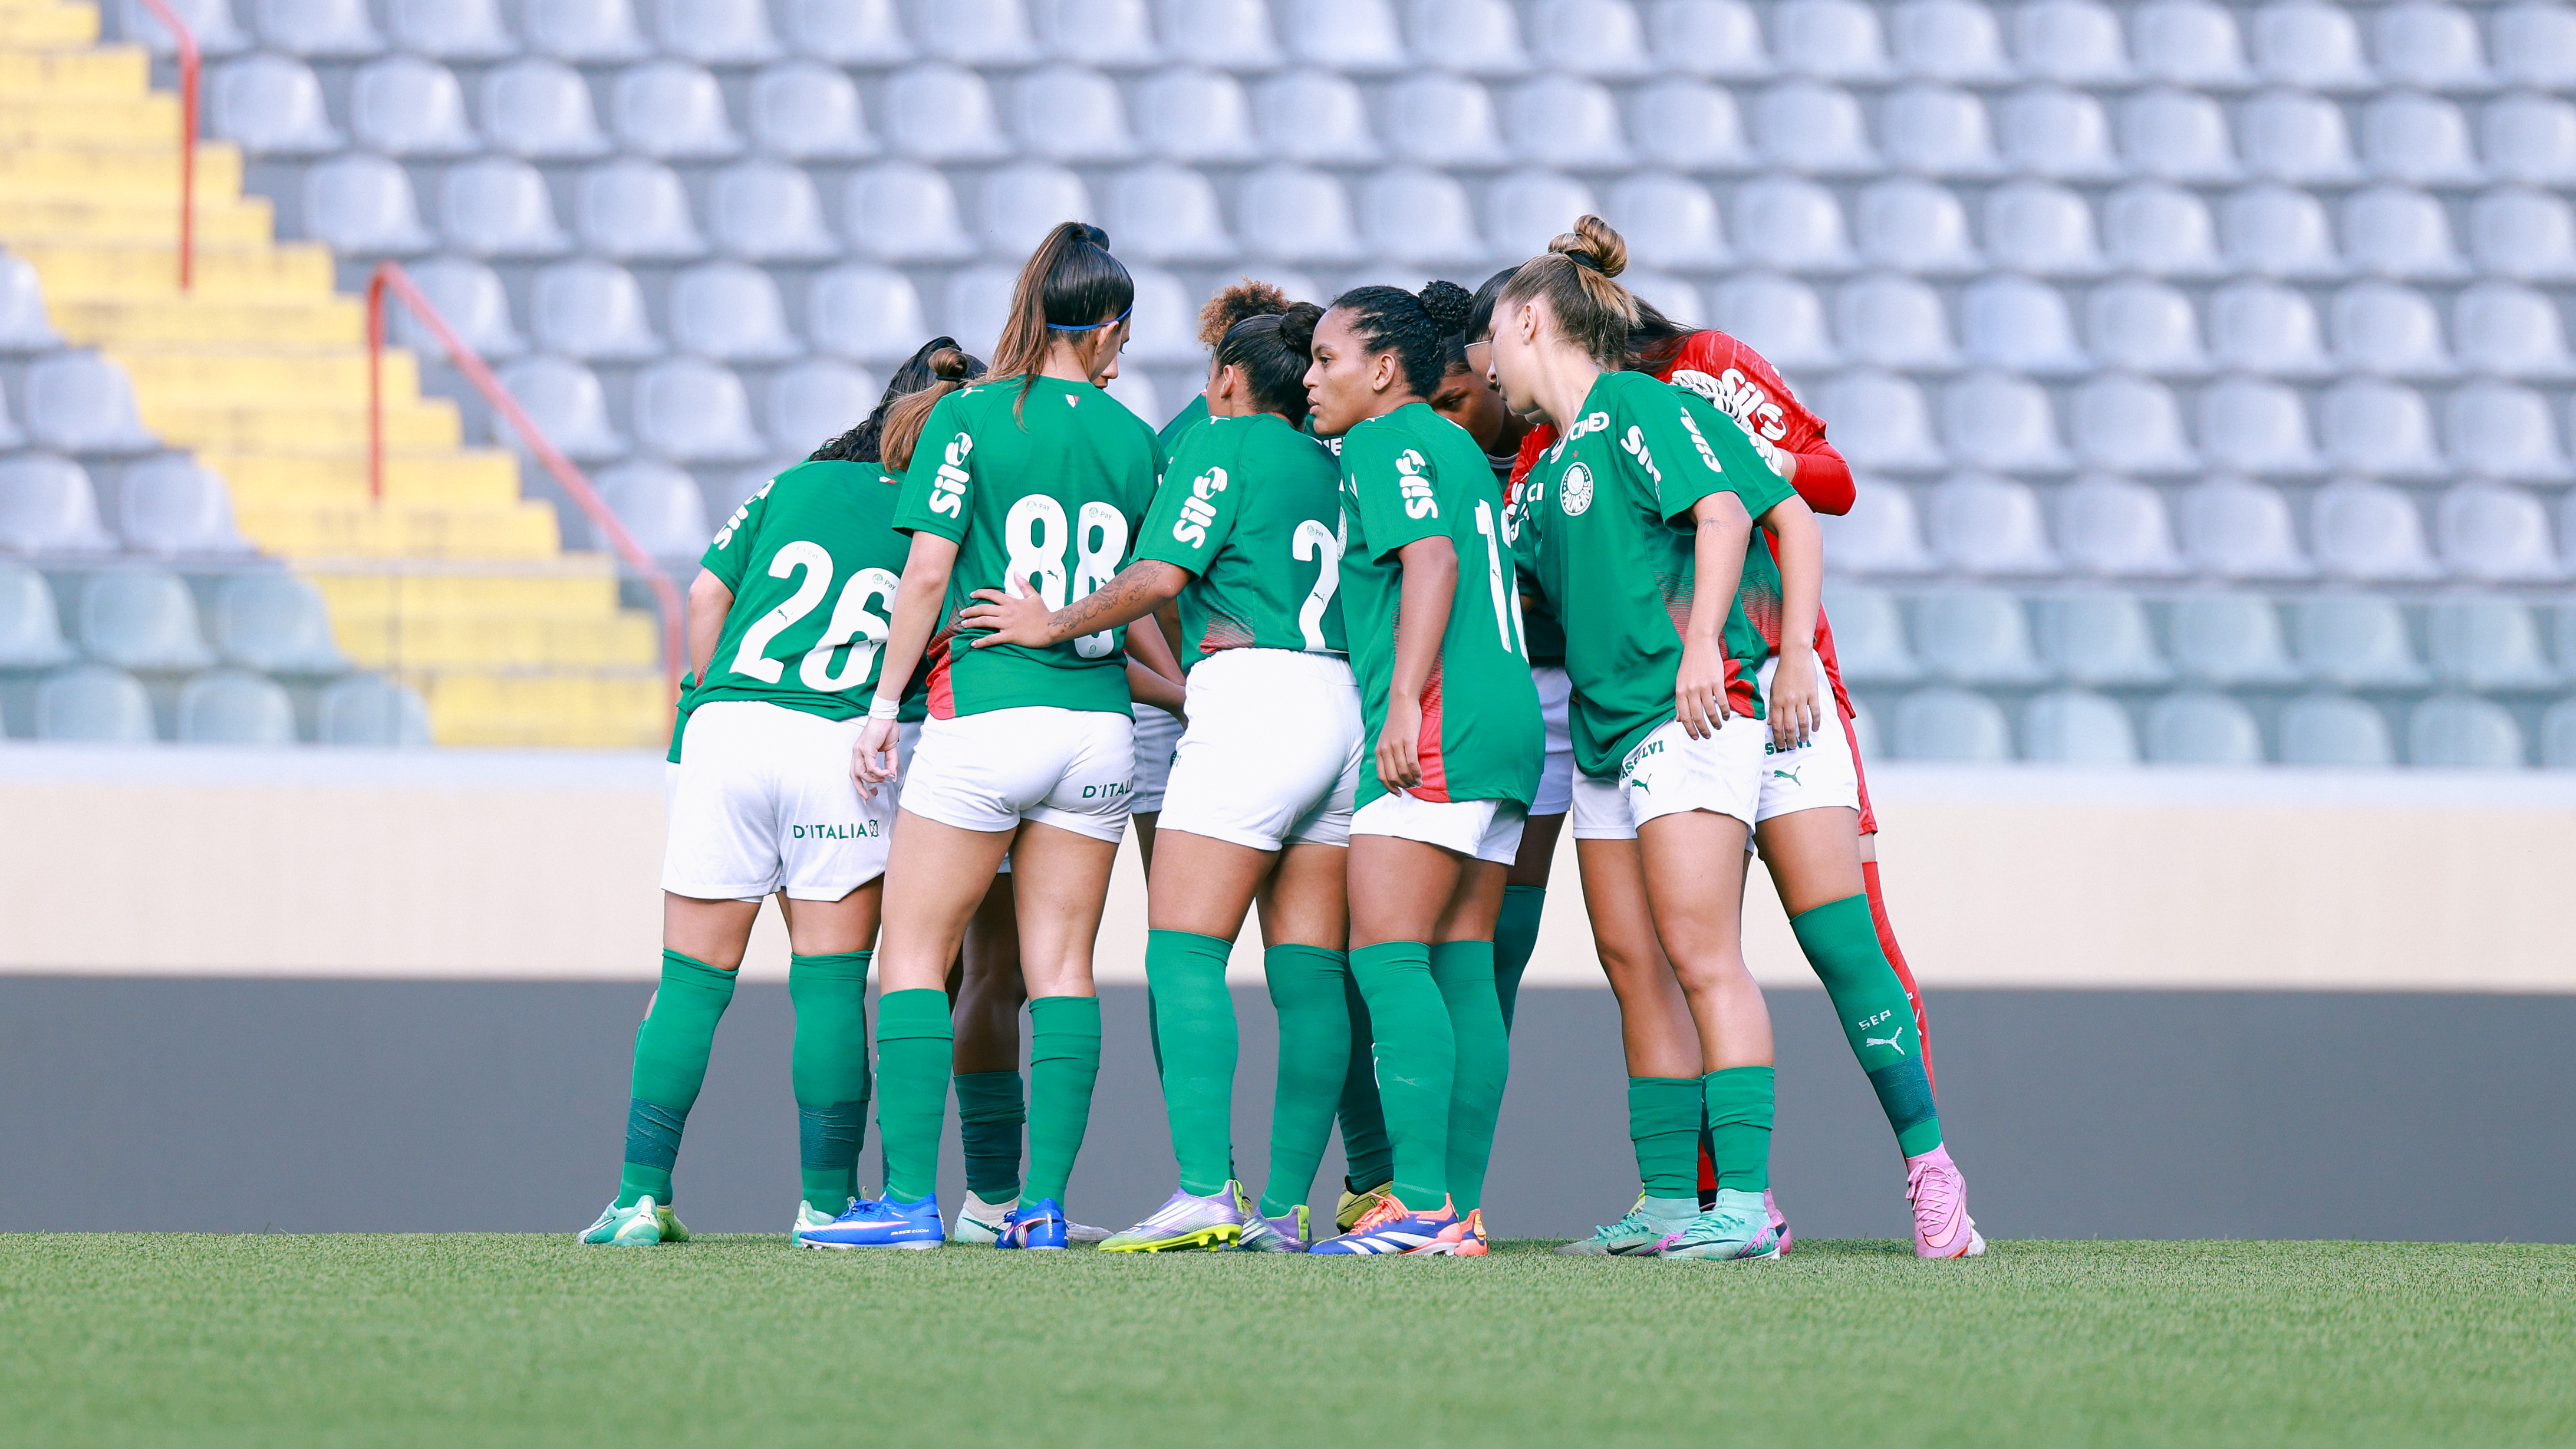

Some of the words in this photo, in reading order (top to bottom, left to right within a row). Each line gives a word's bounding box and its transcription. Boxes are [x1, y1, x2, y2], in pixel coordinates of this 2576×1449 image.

[1562, 480, 1592, 513] PALMEIRAS
[884, 579, 897, 591] Pay
[1004, 493, 1128, 658] 88
[729, 540, 901, 691] 26
[1858, 1009, 1892, 1030] SEP
